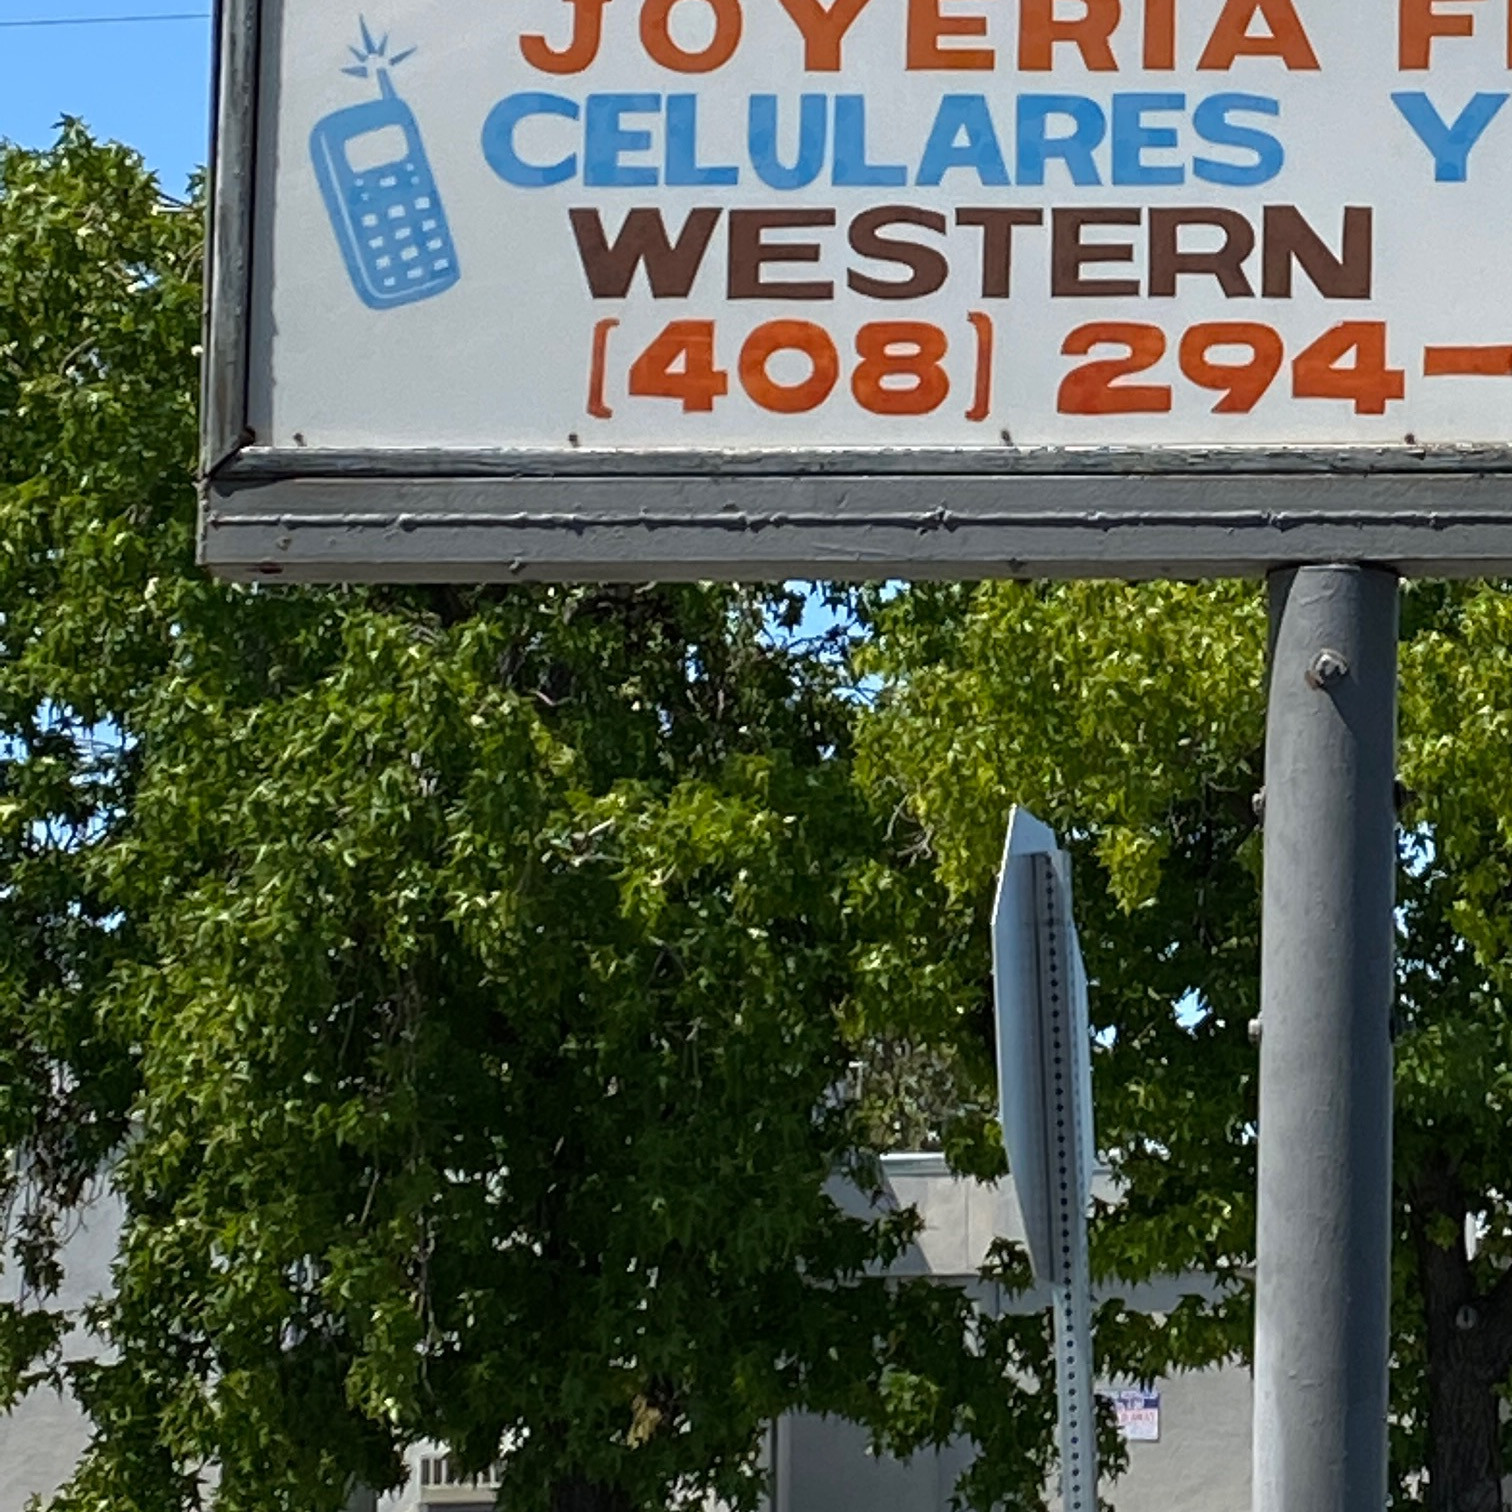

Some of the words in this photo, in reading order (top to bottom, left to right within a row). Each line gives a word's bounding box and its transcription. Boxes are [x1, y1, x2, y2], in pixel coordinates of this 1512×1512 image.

[481, 91, 1286, 191] CELULARES
[1391, 91, 1510, 183] Y
[568, 205, 1373, 301] WESTERN
